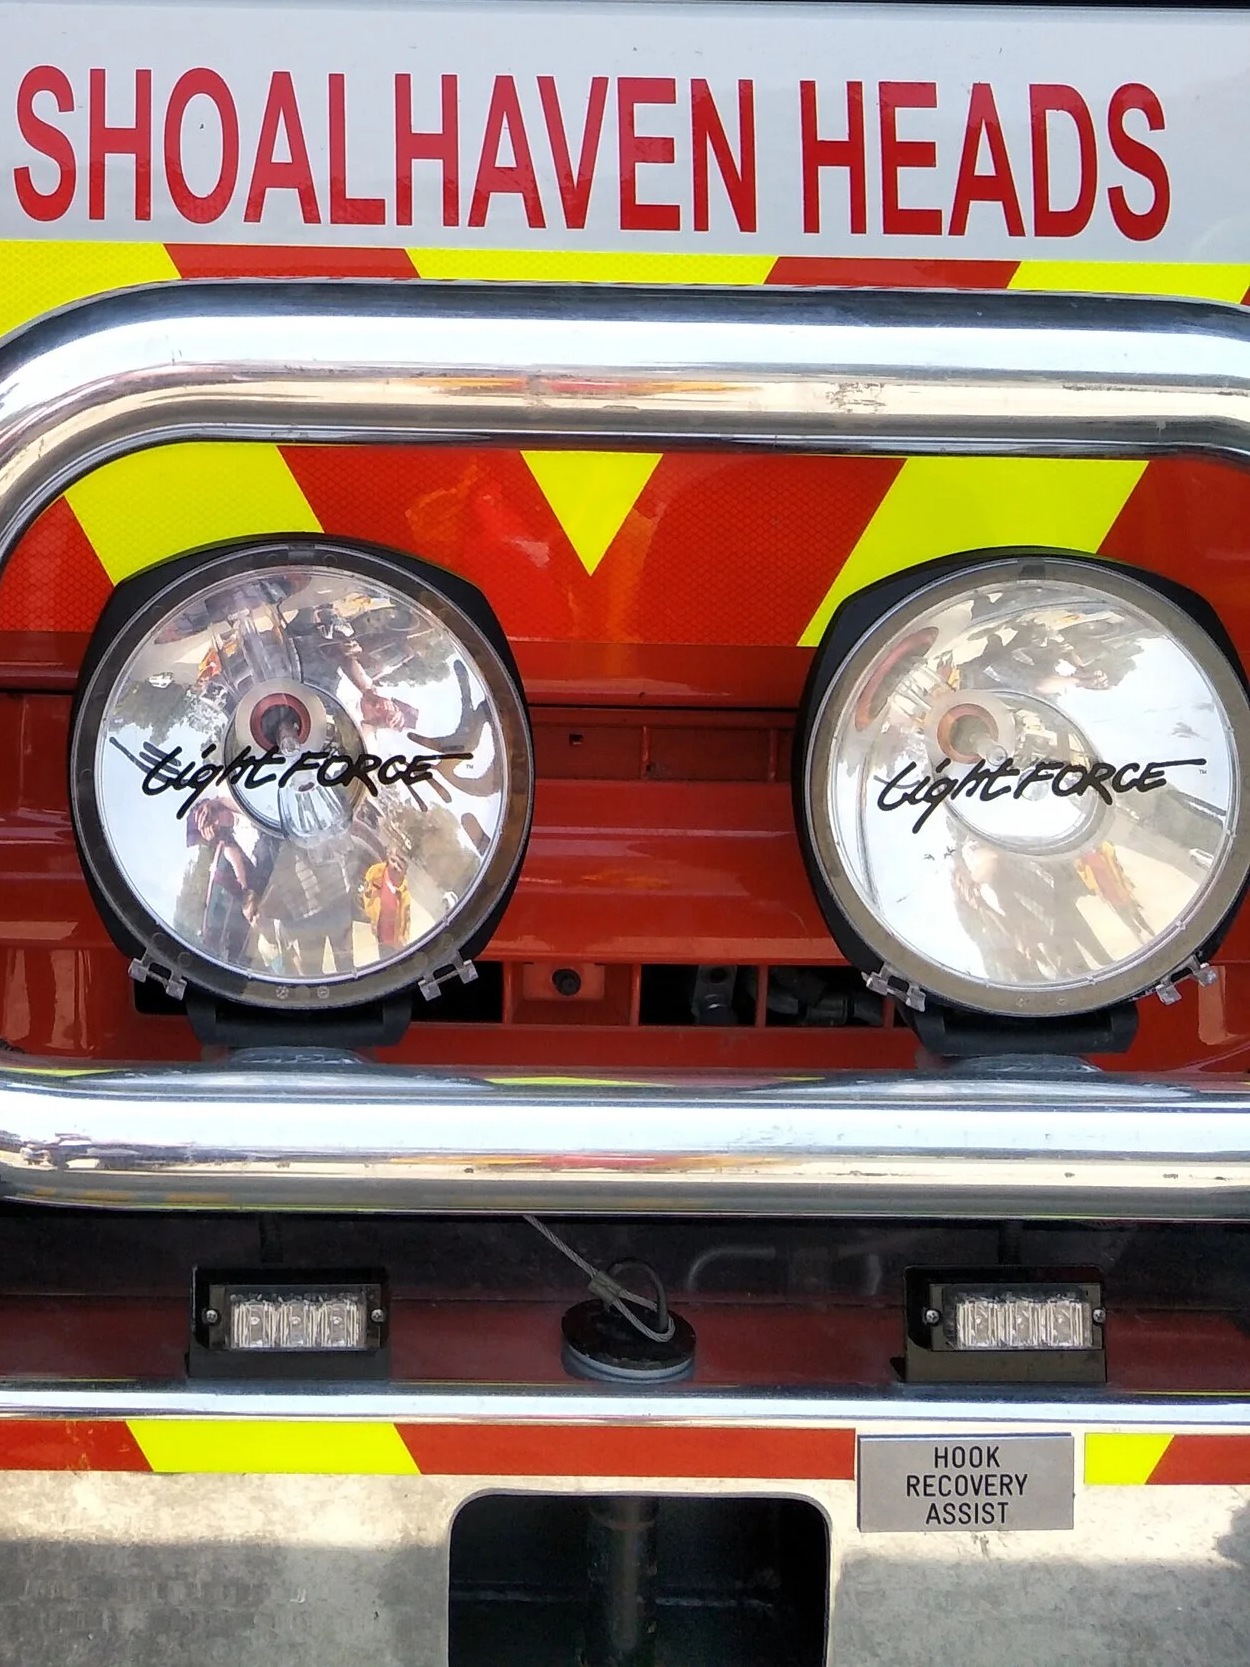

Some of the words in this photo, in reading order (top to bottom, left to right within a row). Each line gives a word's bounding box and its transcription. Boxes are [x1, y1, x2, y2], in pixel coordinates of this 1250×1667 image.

[13, 64, 756, 232] SHOALHAVEN
[800, 79, 1172, 241] HEADS
[934, 1446, 1000, 1468] HOOK
[906, 1474, 1028, 1497] RECOVERY
[925, 1502, 1009, 1525] ASSIST
